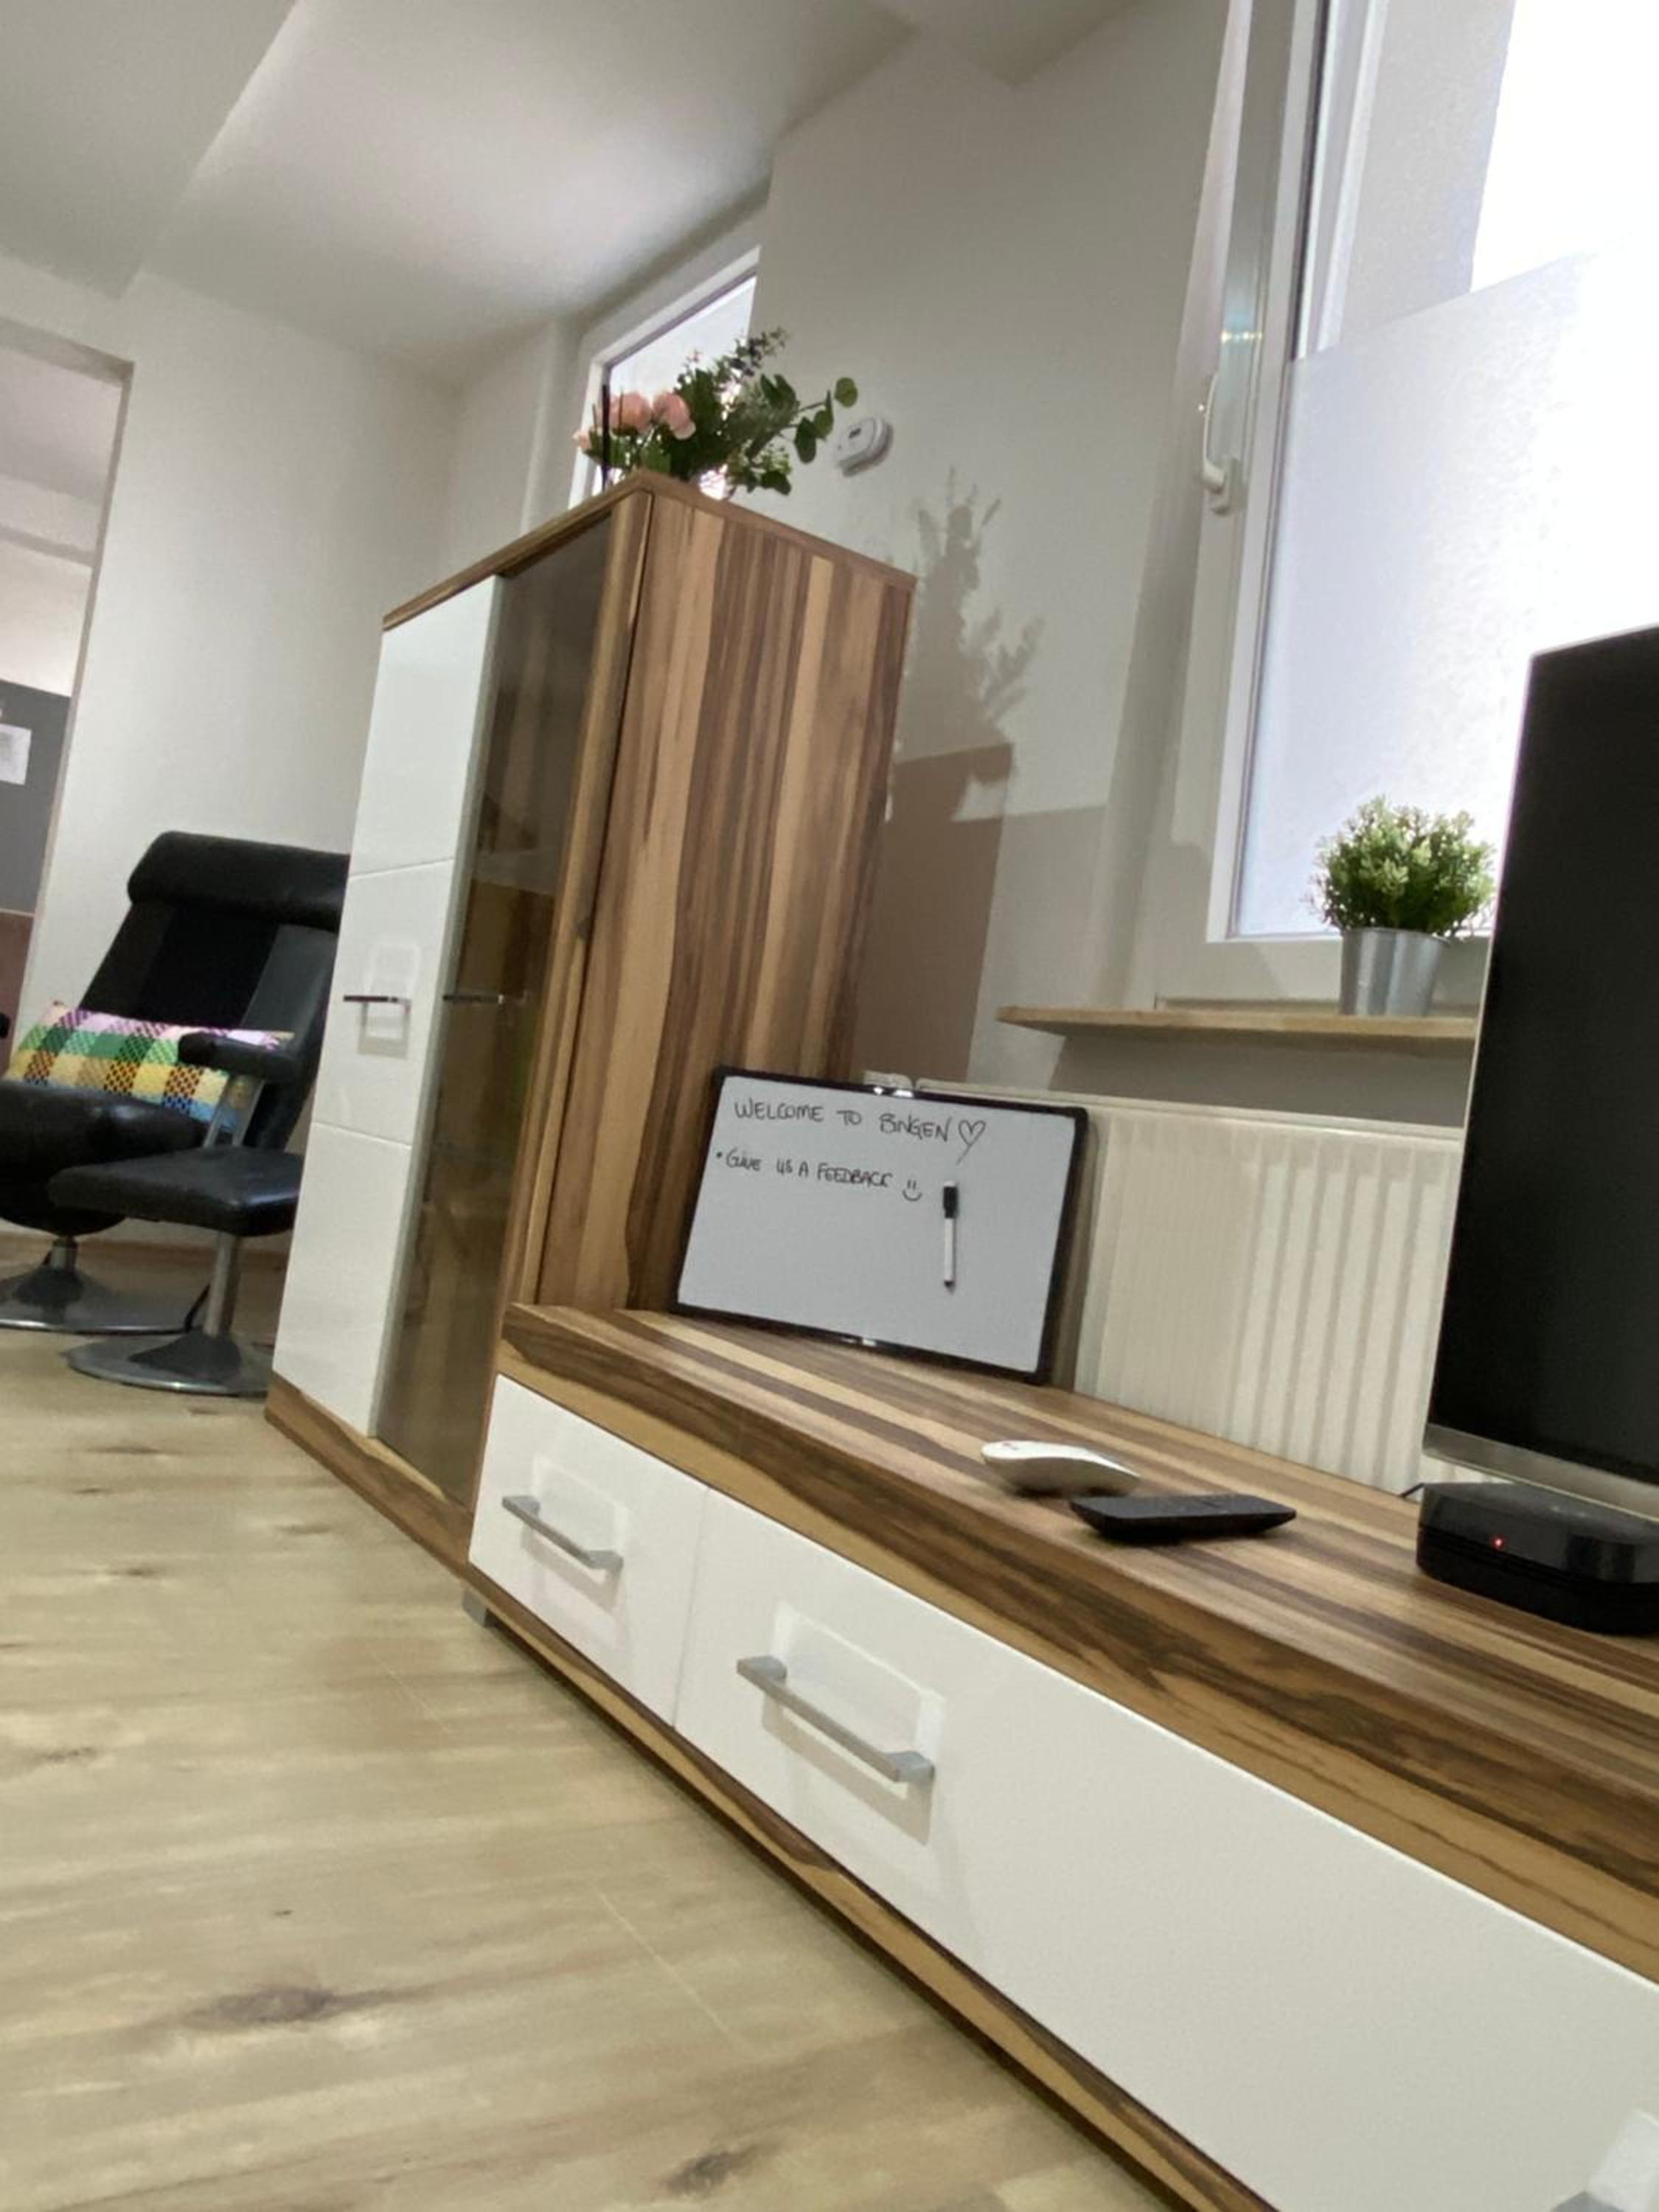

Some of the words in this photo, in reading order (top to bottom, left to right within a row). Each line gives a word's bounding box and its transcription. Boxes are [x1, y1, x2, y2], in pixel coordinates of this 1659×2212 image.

[734, 1097, 824, 1122] WELCOME
[836, 1110, 862, 1126] TO
[798, 1161, 809, 1177] A
[817, 1162, 893, 1187] FEEDBACK
